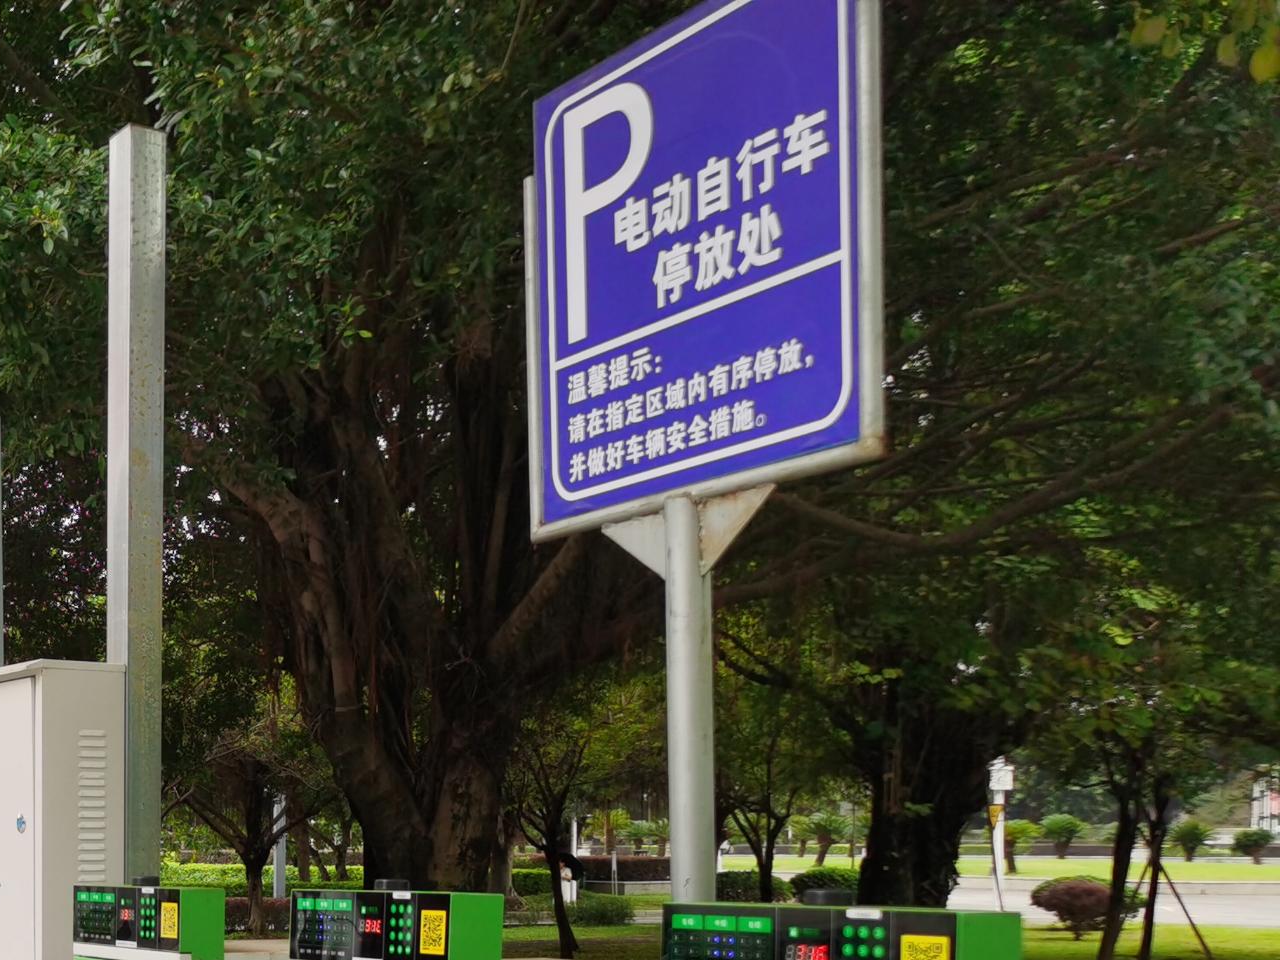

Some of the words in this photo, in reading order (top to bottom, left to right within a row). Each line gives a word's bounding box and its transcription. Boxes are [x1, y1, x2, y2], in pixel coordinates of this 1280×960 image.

[563, 82, 652, 344] P
[614, 109, 830, 252] 电动自行车
[652, 203, 783, 308] 停放处
[568, 347, 662, 404] 温馨提示：
[569, 338, 814, 444] 请在指定区域内有序停放，
[569, 400, 767, 483] 并做好车辆安全措施。
